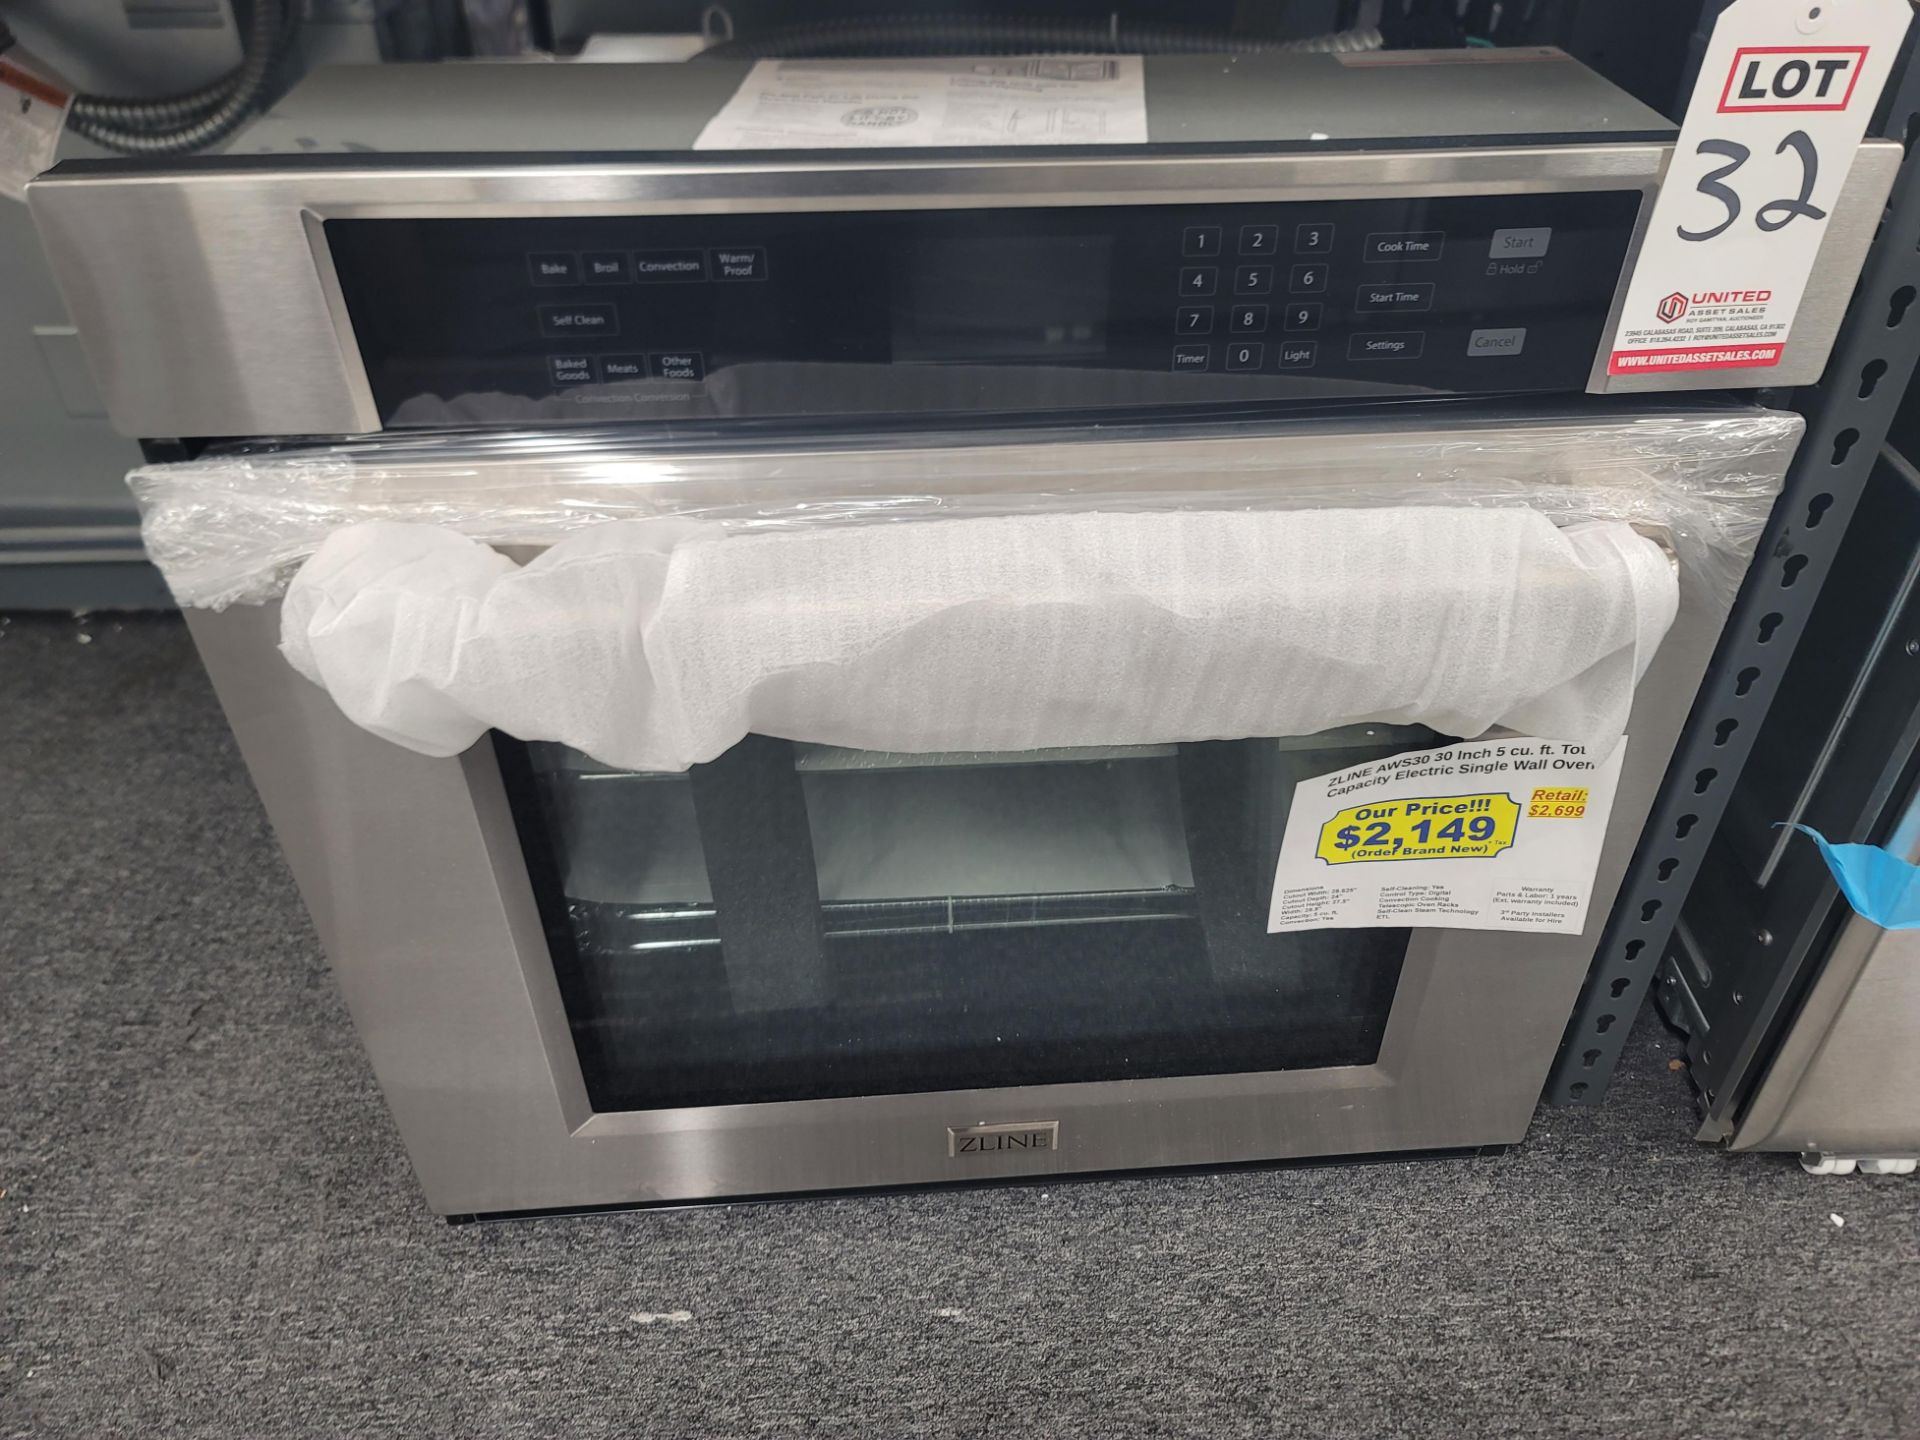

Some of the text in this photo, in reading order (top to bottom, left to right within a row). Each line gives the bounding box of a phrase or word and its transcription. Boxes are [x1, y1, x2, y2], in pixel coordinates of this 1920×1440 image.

[1738, 59, 1850, 99] LOT
[1676, 129, 1827, 242] 32
[1197, 233, 1205, 249] 1
[1251, 232, 1263, 248] 2
[1308, 231, 1319, 246] 3
[1503, 236, 1535, 249] Start
[1377, 240, 1430, 252] Cook Time
[719, 252, 756, 264] Warm/
[540, 263, 568, 275] Bake
[593, 262, 620, 274] Broil
[638, 260, 700, 273] Convection
[723, 265, 753, 277] Proof
[1499, 264, 1526, 275] Hold
[1191, 273, 1203, 288] 4
[1247, 272, 1258, 287] 5
[1303, 270, 1314, 285] 6
[1369, 292, 1420, 303] Start Time
[1692, 290, 1772, 304] UNITED
[1298, 310, 1309, 324] 9
[1688, 307, 1766, 317] ASSET SALES
[552, 314, 605, 326] Self Clean
[1189, 313, 1200, 328] 7
[1243, 312, 1254, 326] 8
[1643, 328, 1677, 336] CALABASAS
[1366, 340, 1405, 352] Settings
[1475, 336, 1516, 349] Cancel
[661, 356, 693, 367] Other
[1176, 353, 1206, 364] Timer
[1239, 349, 1250, 363] 0
[1284, 350, 1311, 363] Light
[1617, 349, 1775, 368] WWW.UNITEDASSETSALES.COM
[554, 359, 588, 370] Baked
[606, 364, 639, 375] Meats
[556, 370, 591, 381] Goods
[663, 367, 696, 378] Foods
[1327, 766, 1373, 788] ZLINE
[1376, 754, 1431, 774] AWS30
[1434, 750, 1453, 763] 30
[1457, 748, 1492, 761] Inch
[1496, 746, 1506, 757] 5
[1510, 746, 1534, 756] cu.
[1540, 744, 1555, 755] ft.
[1326, 774, 1391, 798] Capacity
[1395, 765, 1454, 781] Electric
[1459, 760, 1508, 775] Single
[1514, 759, 1547, 771] Wall
[1531, 788, 1589, 801] Retail:
[1355, 798, 1492, 821] Our Price!!!
[1334, 815, 1497, 851] $2,149
[1351, 844, 1489, 860] (Order Brand New)
[1544, 899, 1579, 908] included)
[1438, 908, 1479, 916] Technology
[1511, 910, 1530, 918] Party
[959, 1133, 1048, 1153] ZLINE
